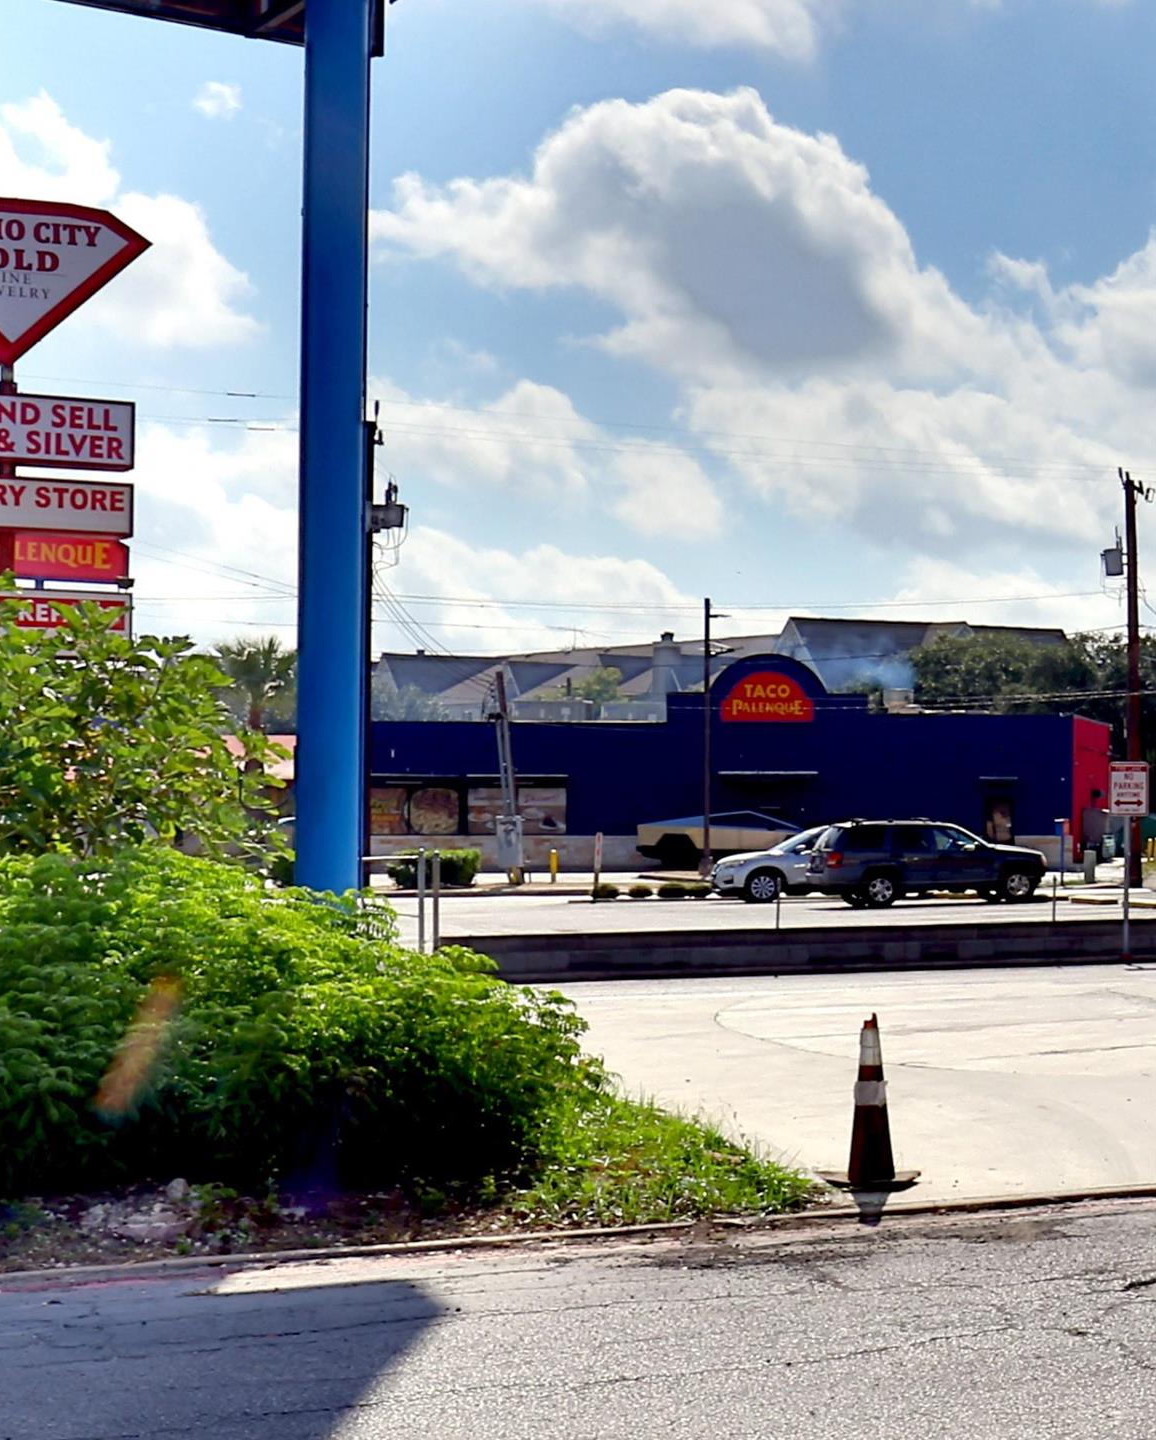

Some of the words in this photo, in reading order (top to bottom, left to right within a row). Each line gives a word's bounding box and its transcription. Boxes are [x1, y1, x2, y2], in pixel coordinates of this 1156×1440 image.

[33, 222, 102, 247] CITY
[51, 404, 118, 432] SELL
[26, 430, 124, 460] SILVER
[34, 486, 125, 512] STORE
[744, 684, 790, 698] TACO
[731, 699, 804, 715] PALENQUE
